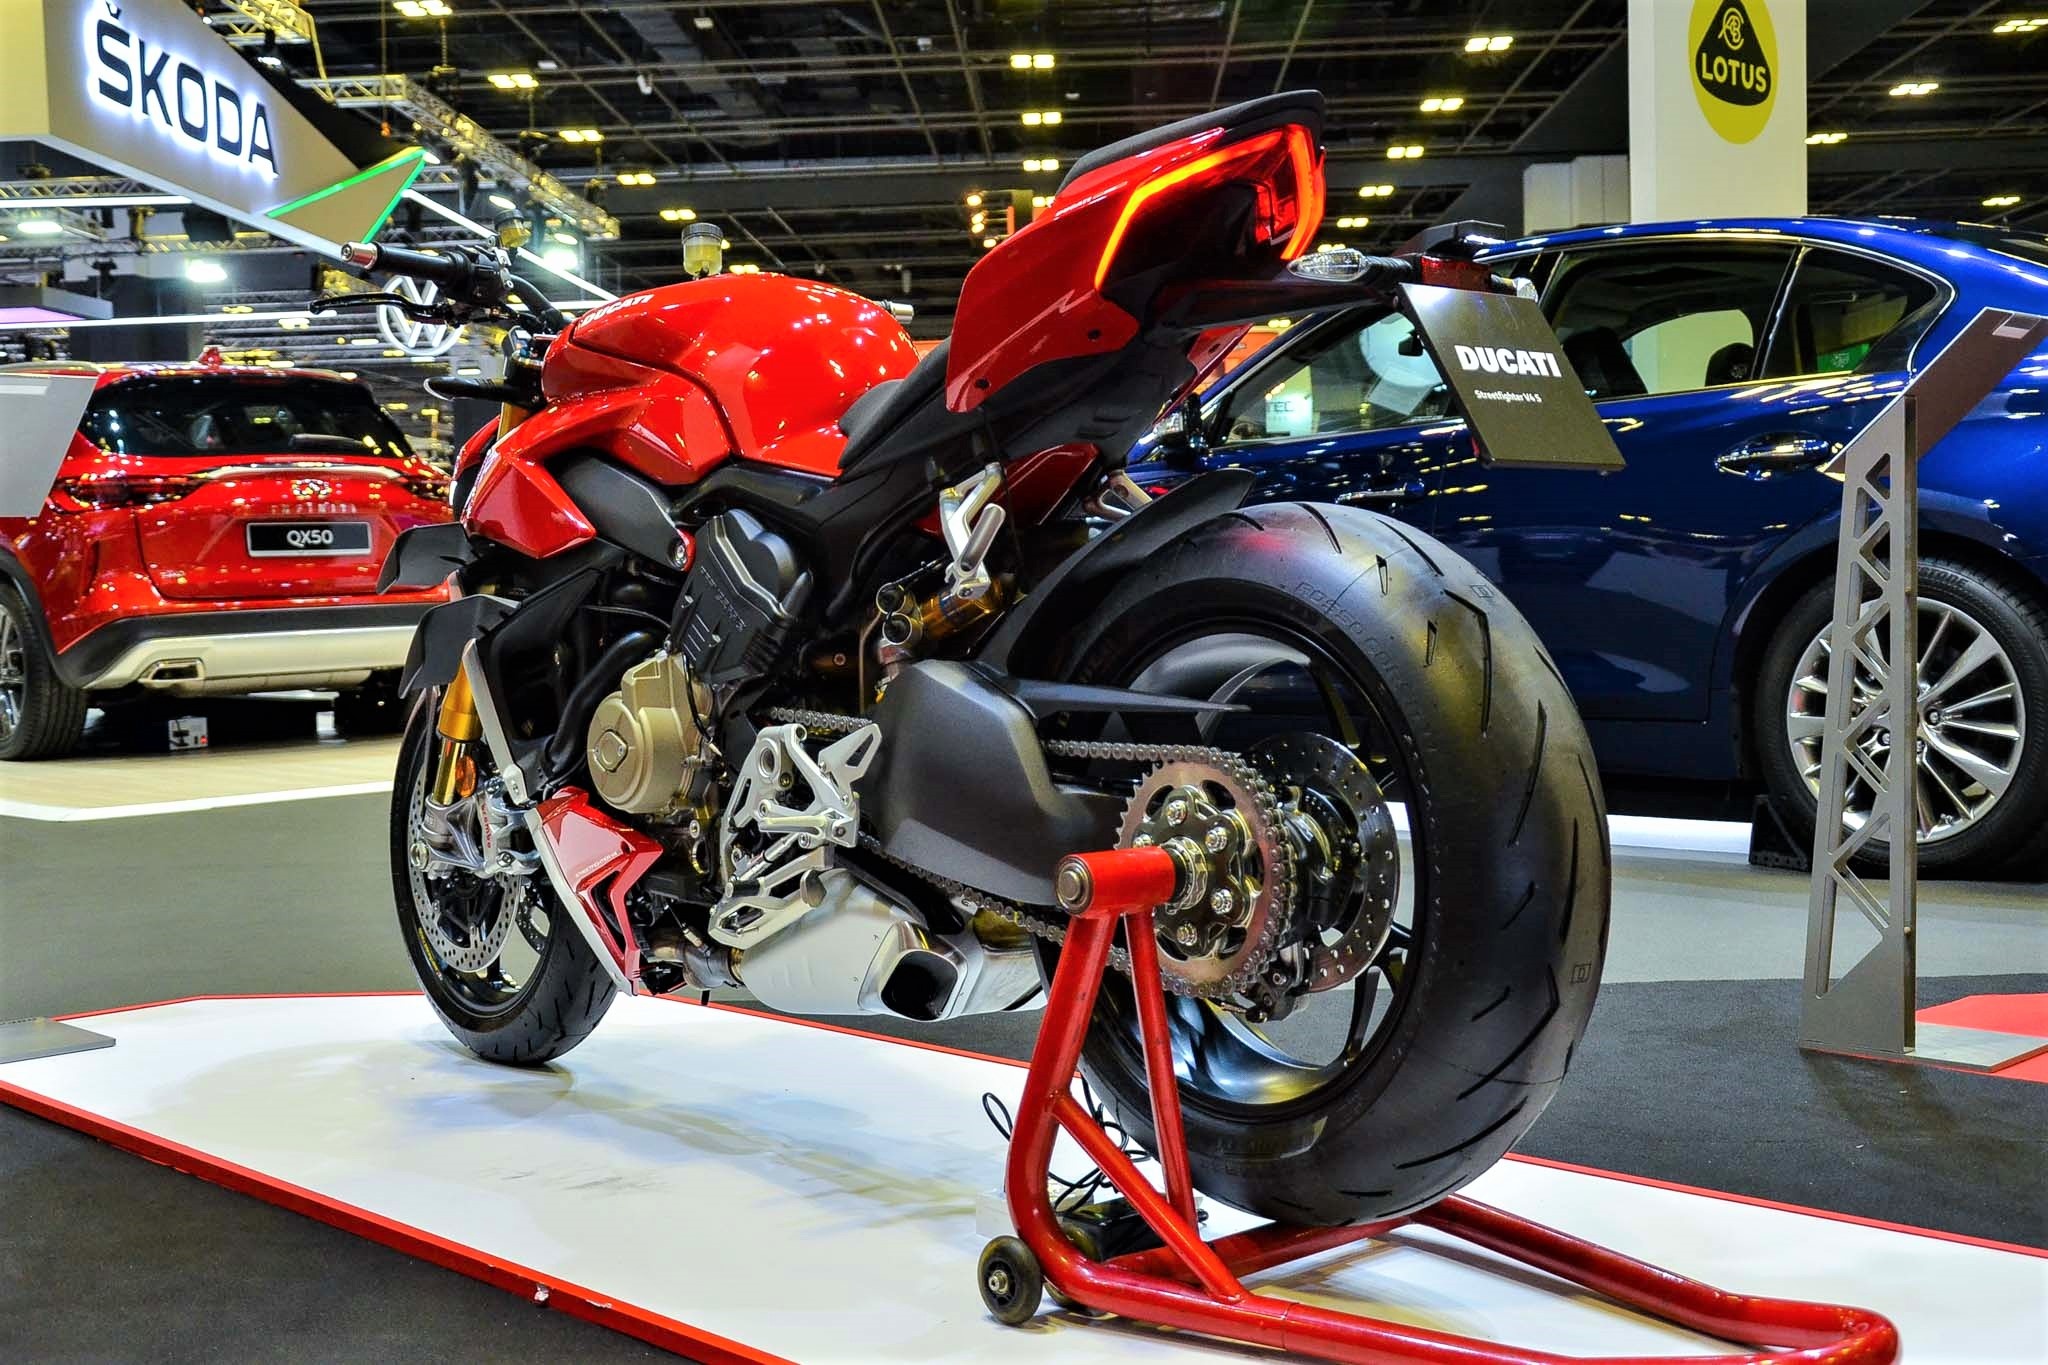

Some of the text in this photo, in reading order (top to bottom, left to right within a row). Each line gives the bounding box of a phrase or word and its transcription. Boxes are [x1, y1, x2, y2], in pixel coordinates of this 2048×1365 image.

[97, 0, 279, 178] ŠKODA
[1702, 53, 1767, 93] LOTUS
[577, 293, 655, 330] DUCATI
[1454, 345, 1562, 378] DUCATI
[1474, 389, 1523, 403] Streetfighter
[1534, 392, 1543, 403] S
[286, 529, 334, 547] QX50
